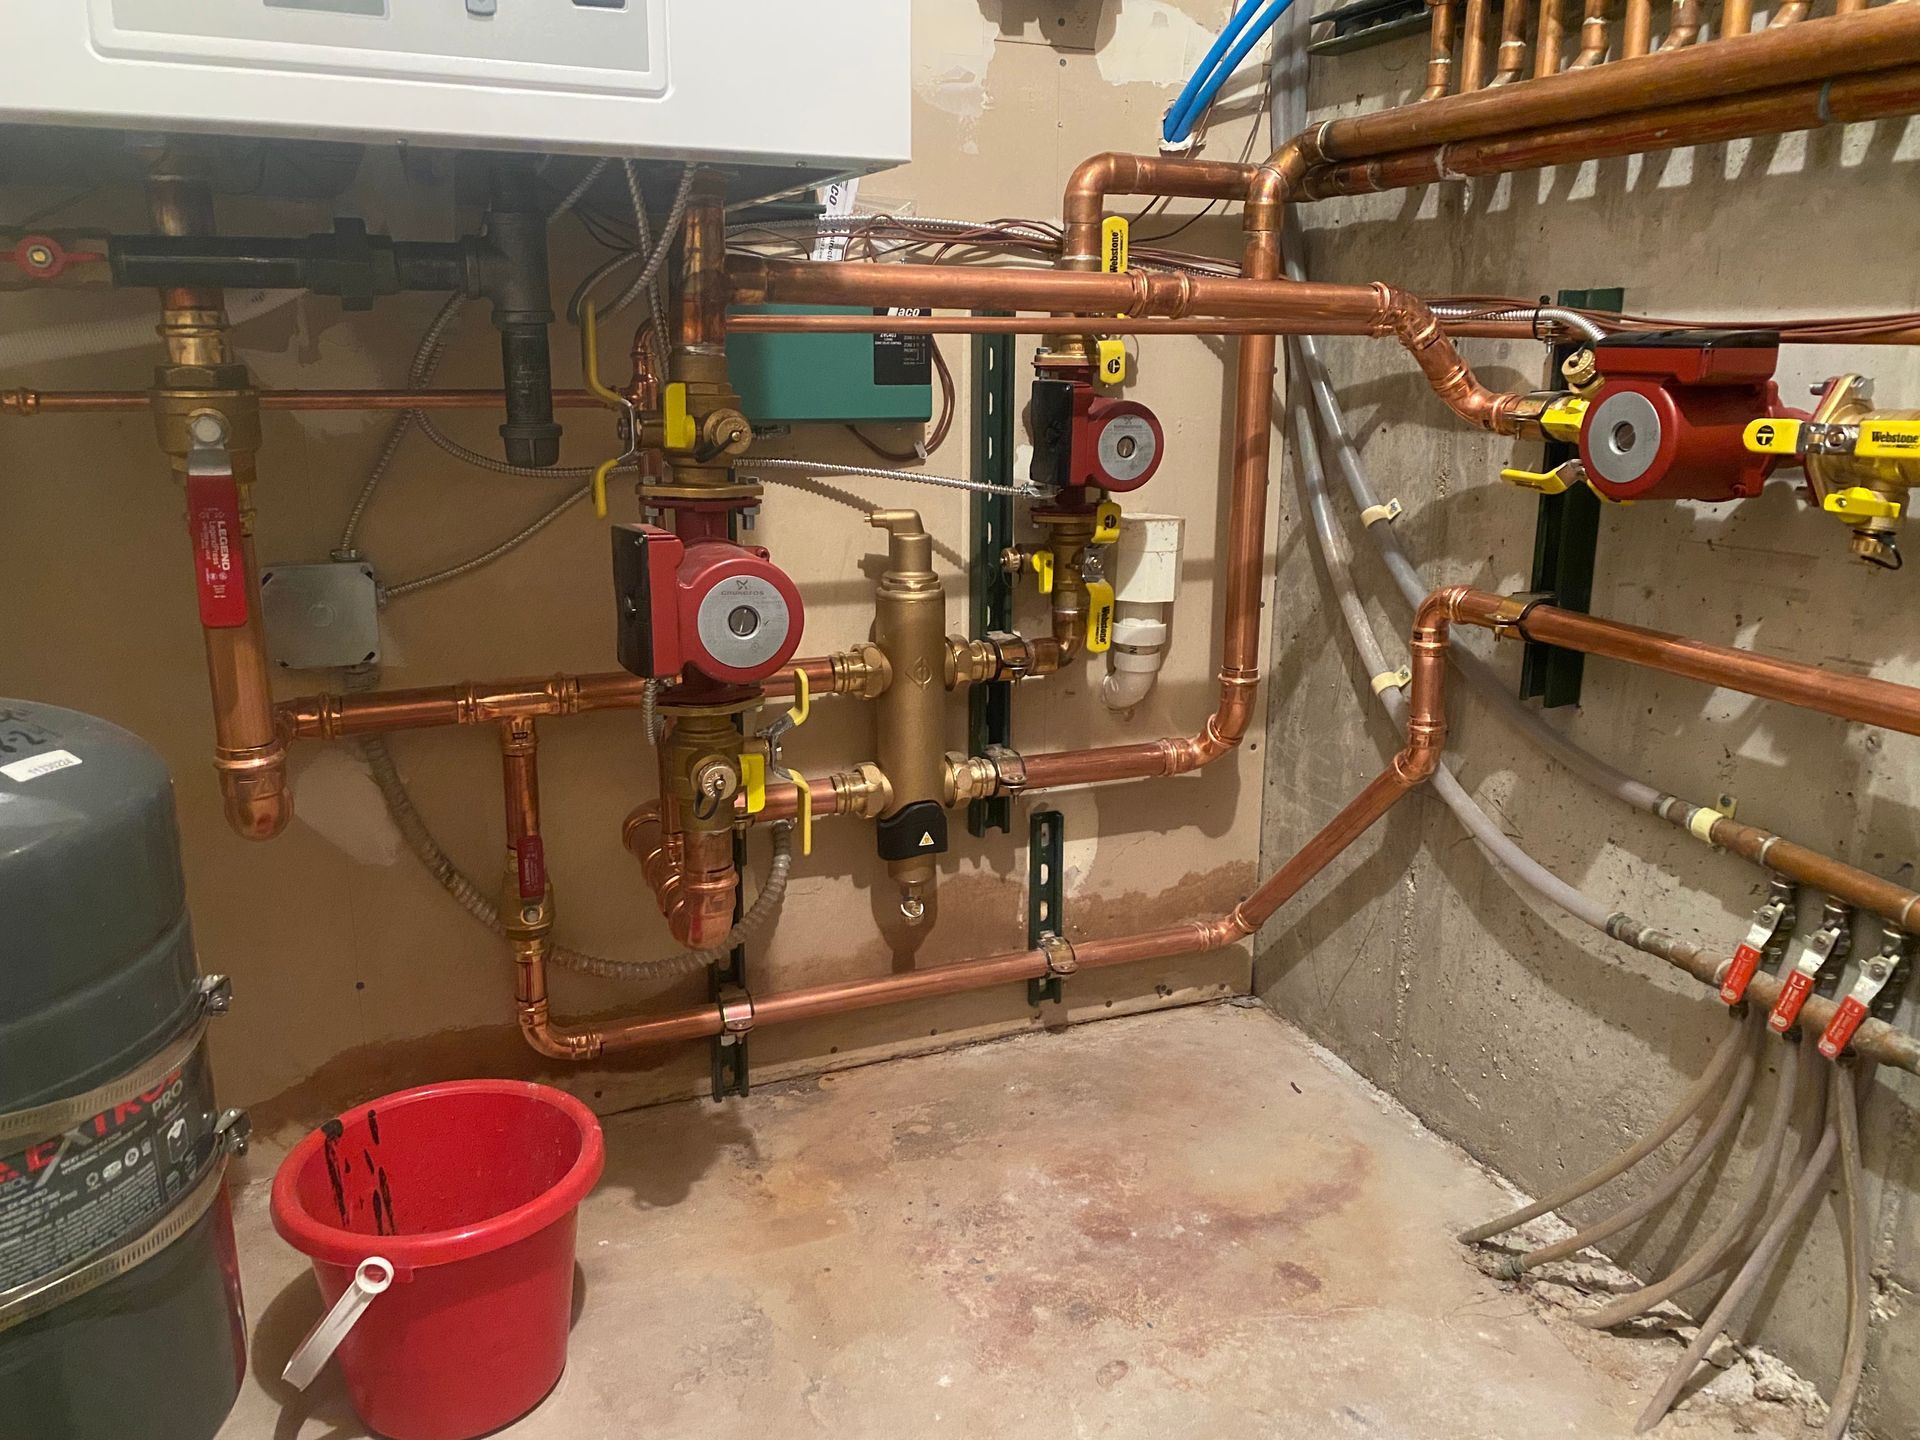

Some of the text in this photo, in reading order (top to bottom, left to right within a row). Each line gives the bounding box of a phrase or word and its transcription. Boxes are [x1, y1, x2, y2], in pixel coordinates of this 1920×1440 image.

[1110, 232, 1119, 272] Webstone
[1871, 431, 1919, 443] Webstone
[217, 521, 231, 571] LEGEND
[1099, 605, 1111, 643] Webstone
[151, 1079, 183, 1117] PRO
